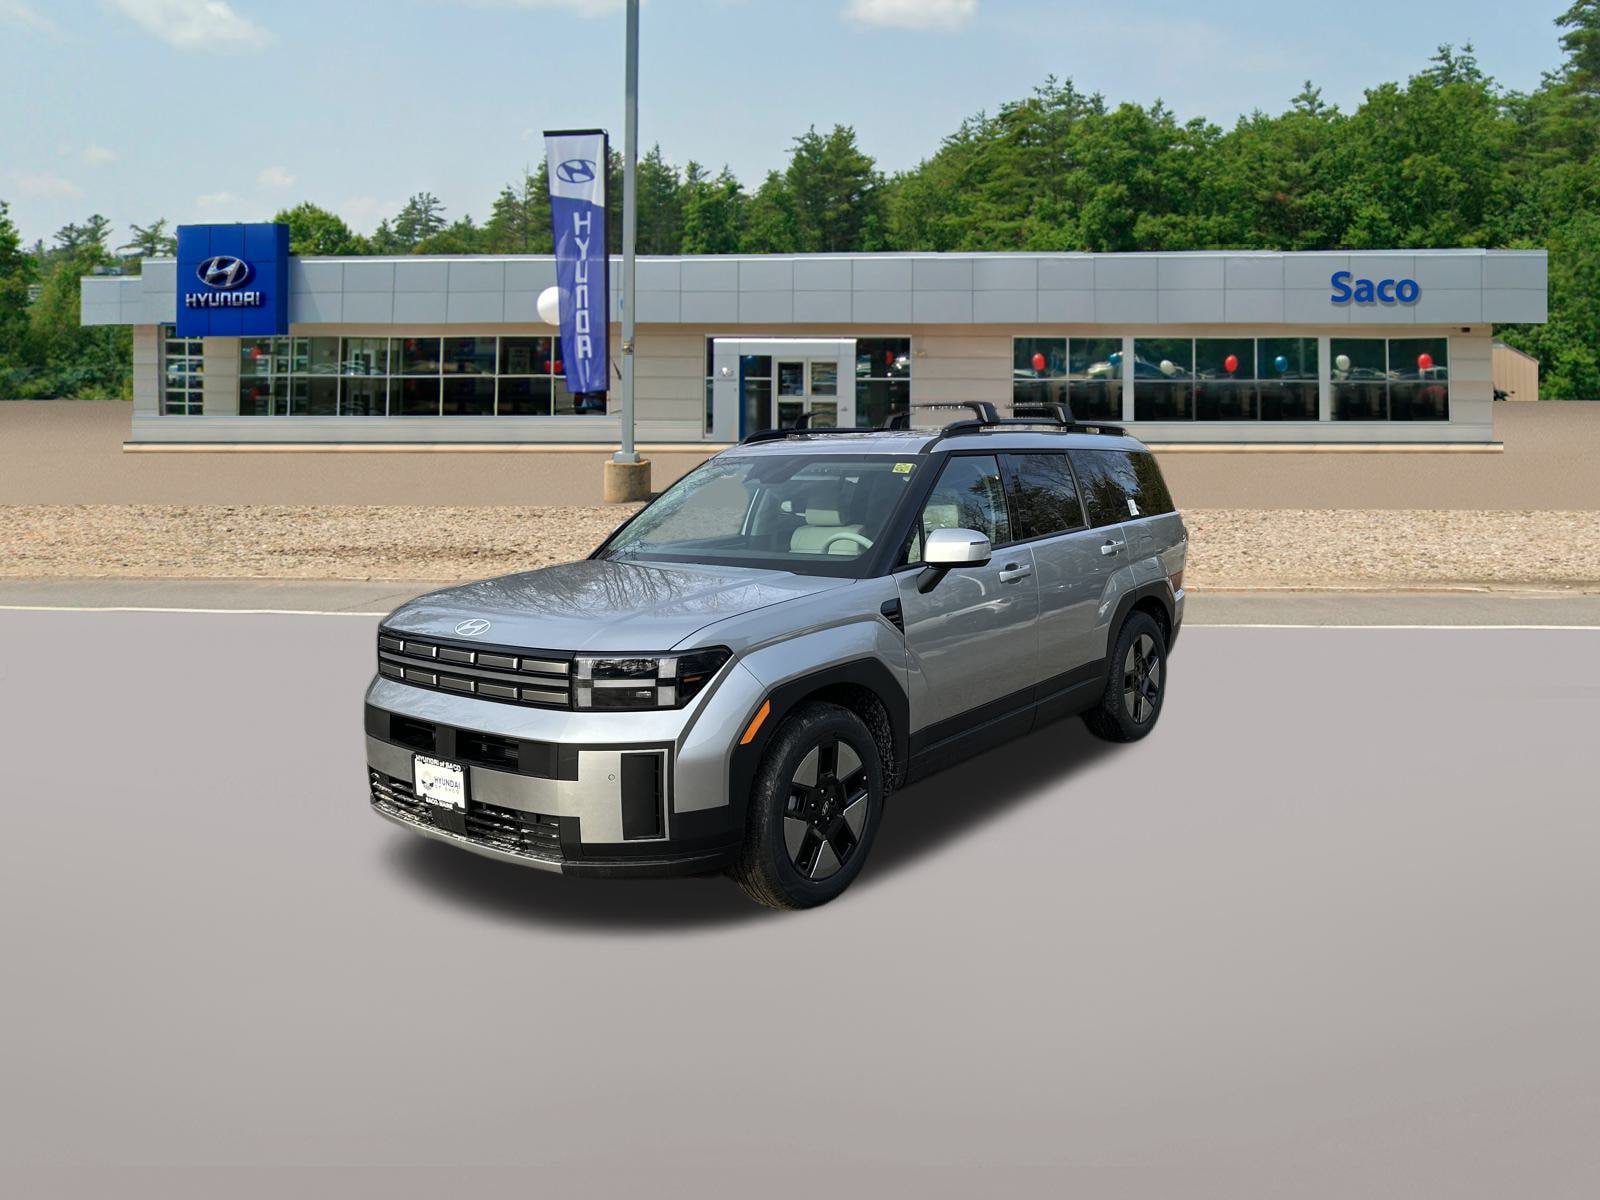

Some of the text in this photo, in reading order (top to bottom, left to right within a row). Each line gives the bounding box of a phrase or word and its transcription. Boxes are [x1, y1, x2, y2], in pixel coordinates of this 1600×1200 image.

[185, 291, 261, 308] HYUNDAI
[573, 211, 592, 383] HYUNDAI
[1331, 271, 1420, 304] Saco
[434, 777, 461, 789] HYUNDAI
